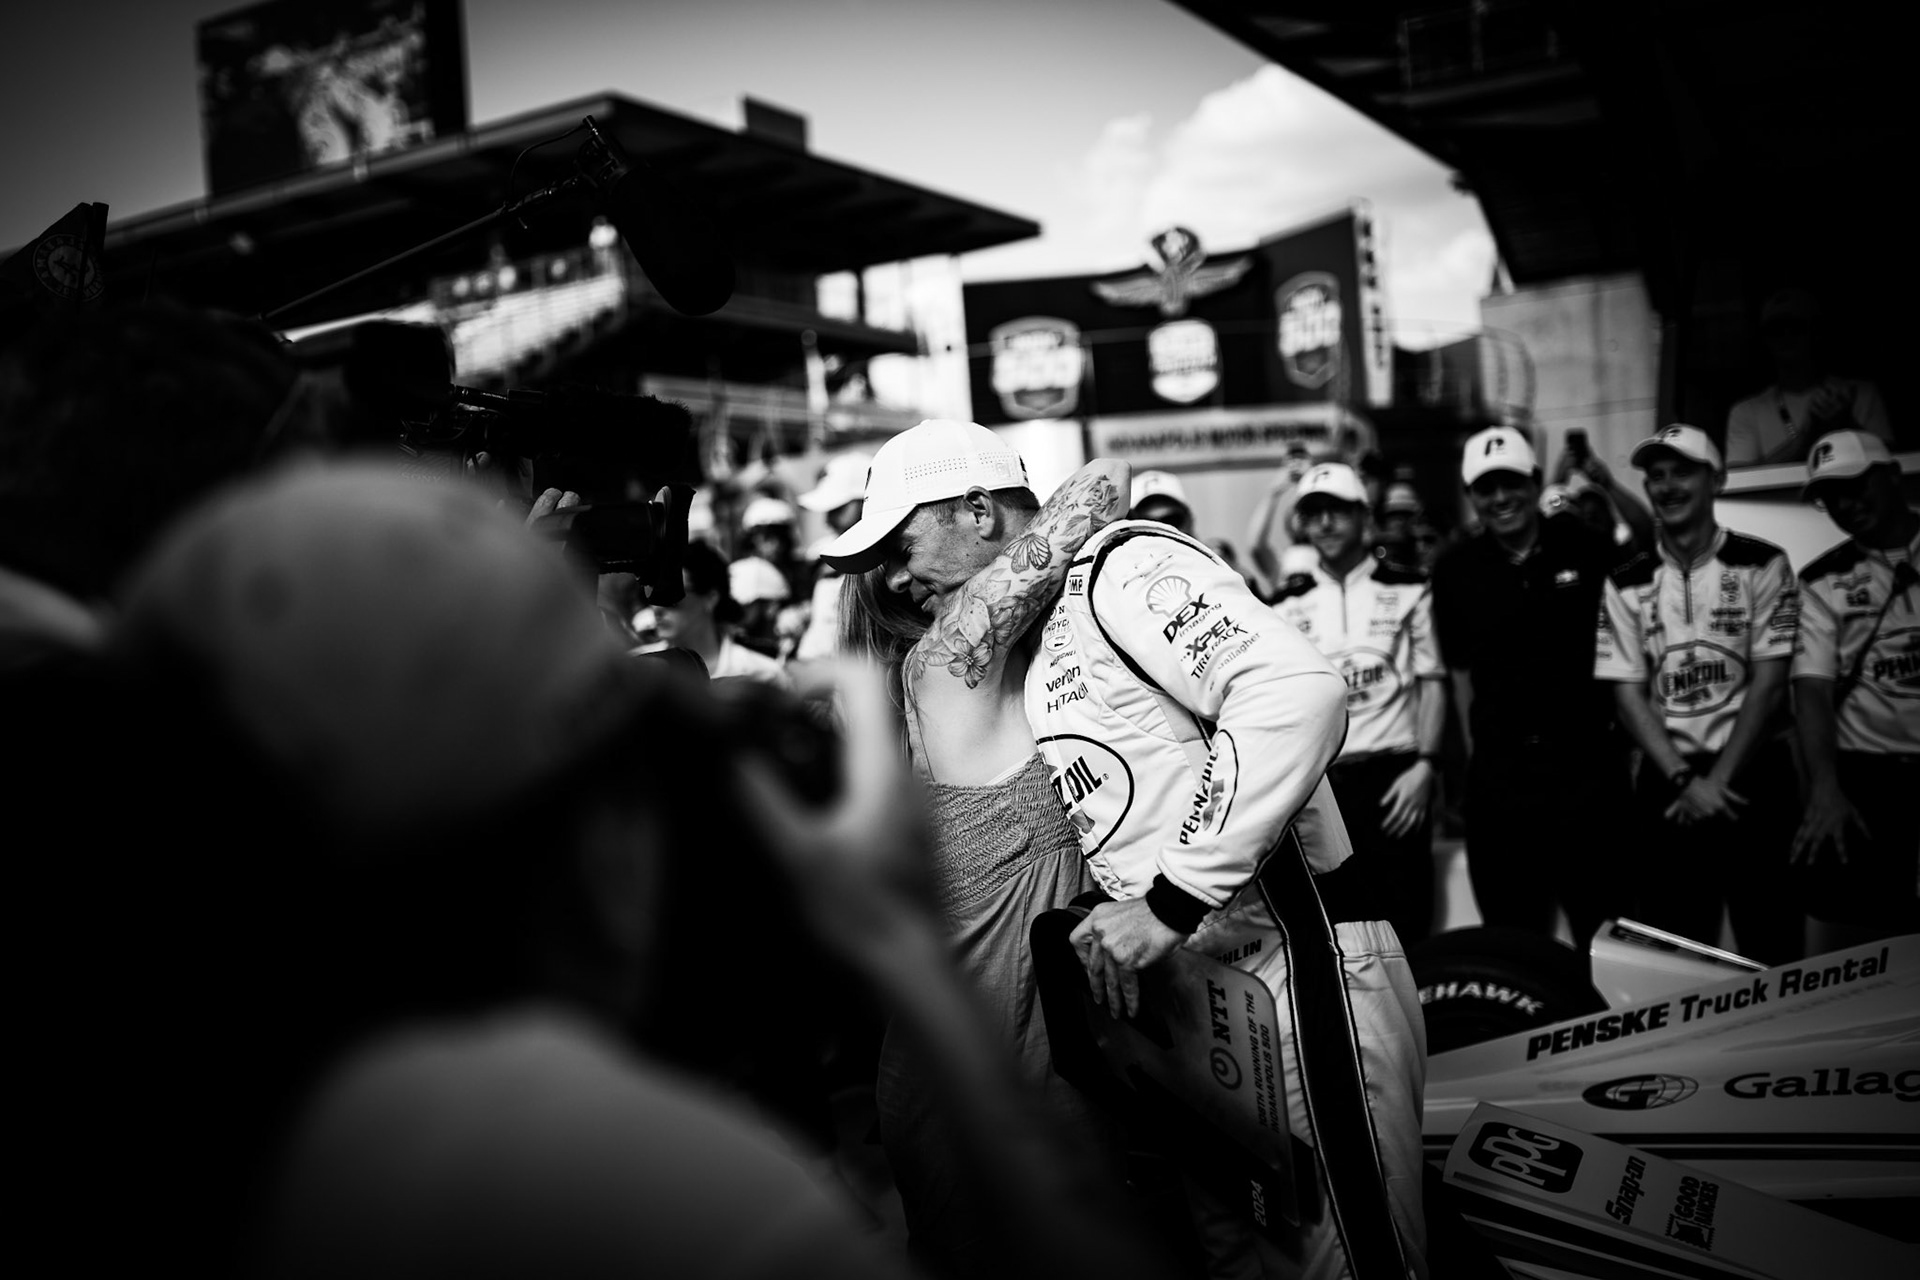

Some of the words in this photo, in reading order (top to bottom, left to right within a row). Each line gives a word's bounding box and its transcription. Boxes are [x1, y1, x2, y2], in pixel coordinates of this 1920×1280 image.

[1069, 578, 1083, 592] MP
[1163, 592, 1210, 645] DEX
[1179, 602, 1222, 638] imaging
[1184, 615, 1236, 662] XPEL
[1052, 755, 1103, 812] ZOIL
[1207, 979, 1231, 1045] NTT
[1244, 990, 1255, 1015] THE
[1247, 1015, 1257, 1035] OF
[1526, 1002, 1670, 1061] PENSKE
[1681, 979, 1768, 1023] Truck
[1778, 947, 1890, 998] Rental
[1260, 1023, 1272, 1050] 500
[1249, 1034, 1264, 1091] RUNNING
[1262, 1049, 1280, 1134] INDIANAPOLIS
[1250, 1179, 1267, 1227] 2024
[1605, 1155, 1646, 1225] Snap-on
[1674, 1176, 1700, 1219] GOOD
